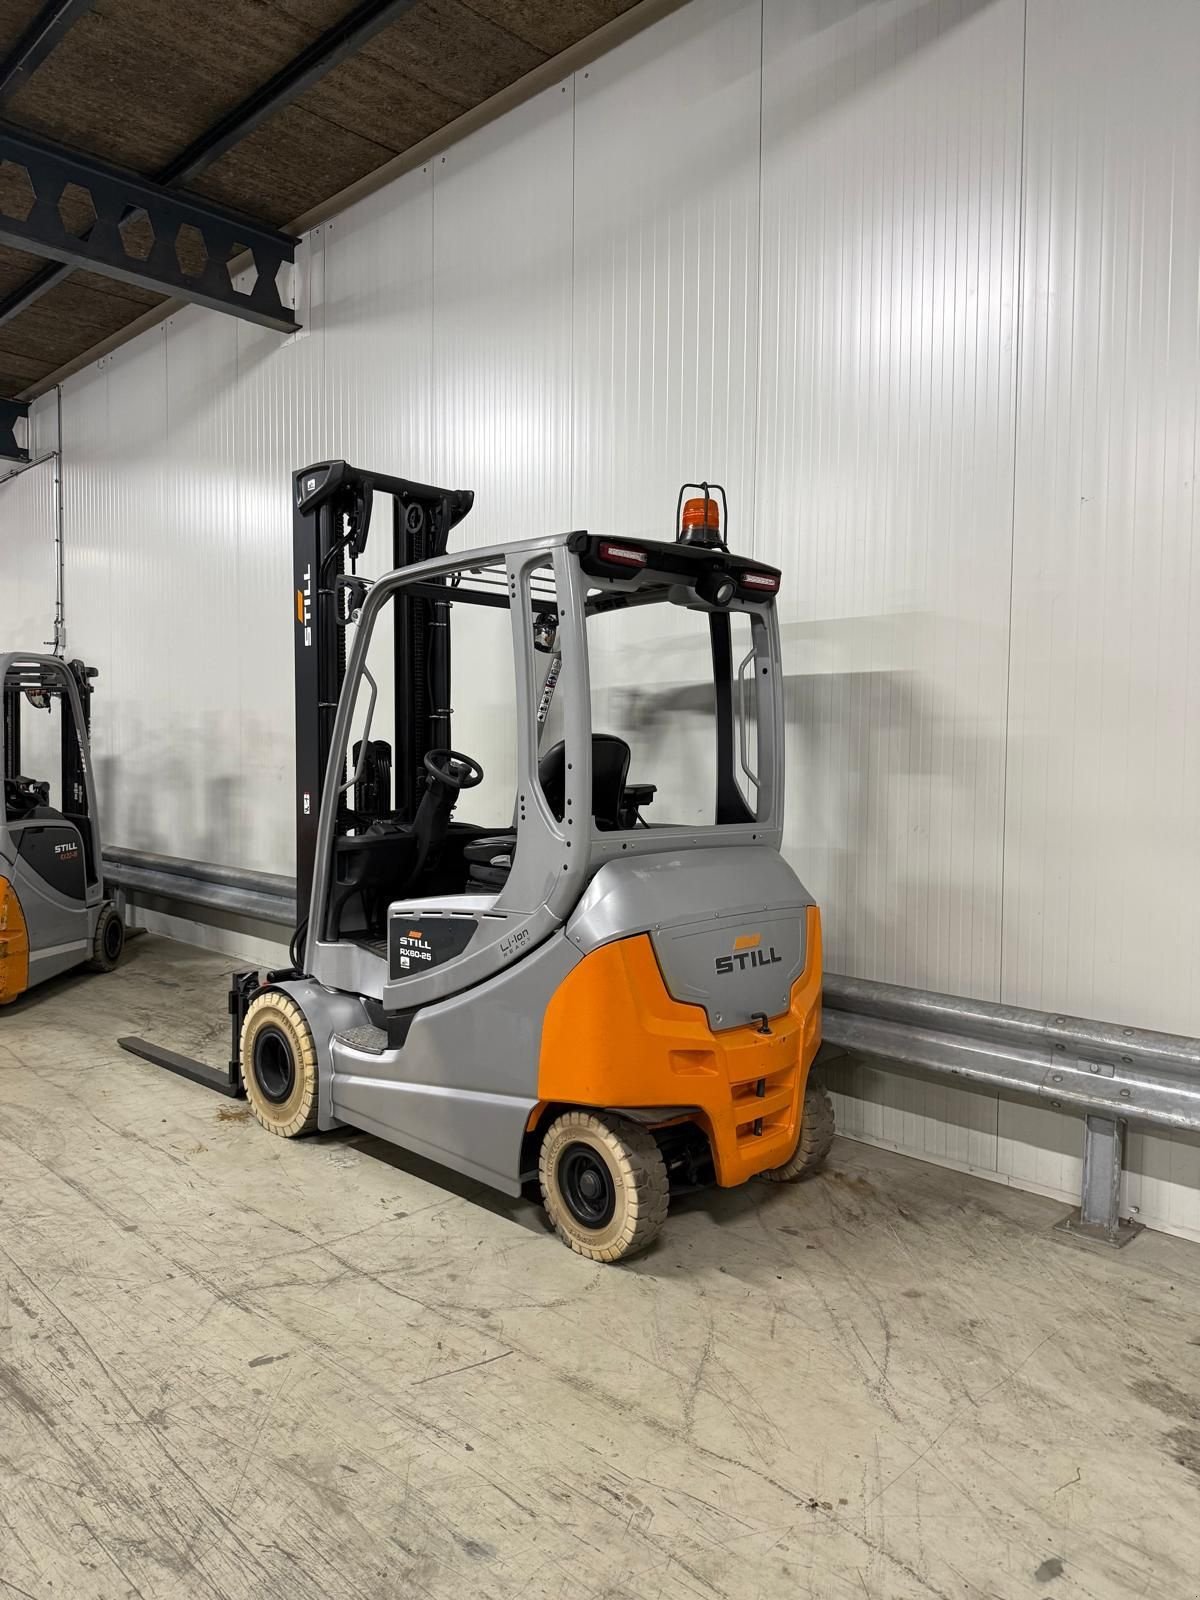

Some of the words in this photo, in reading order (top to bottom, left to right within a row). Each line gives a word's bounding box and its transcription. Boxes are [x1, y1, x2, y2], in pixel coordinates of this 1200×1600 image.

[304, 563, 312, 647] STILL
[55, 842, 78, 854] STILL
[399, 936, 432, 950] STILL
[399, 947, 432, 961] RX60-25
[715, 947, 782, 975] STILL
